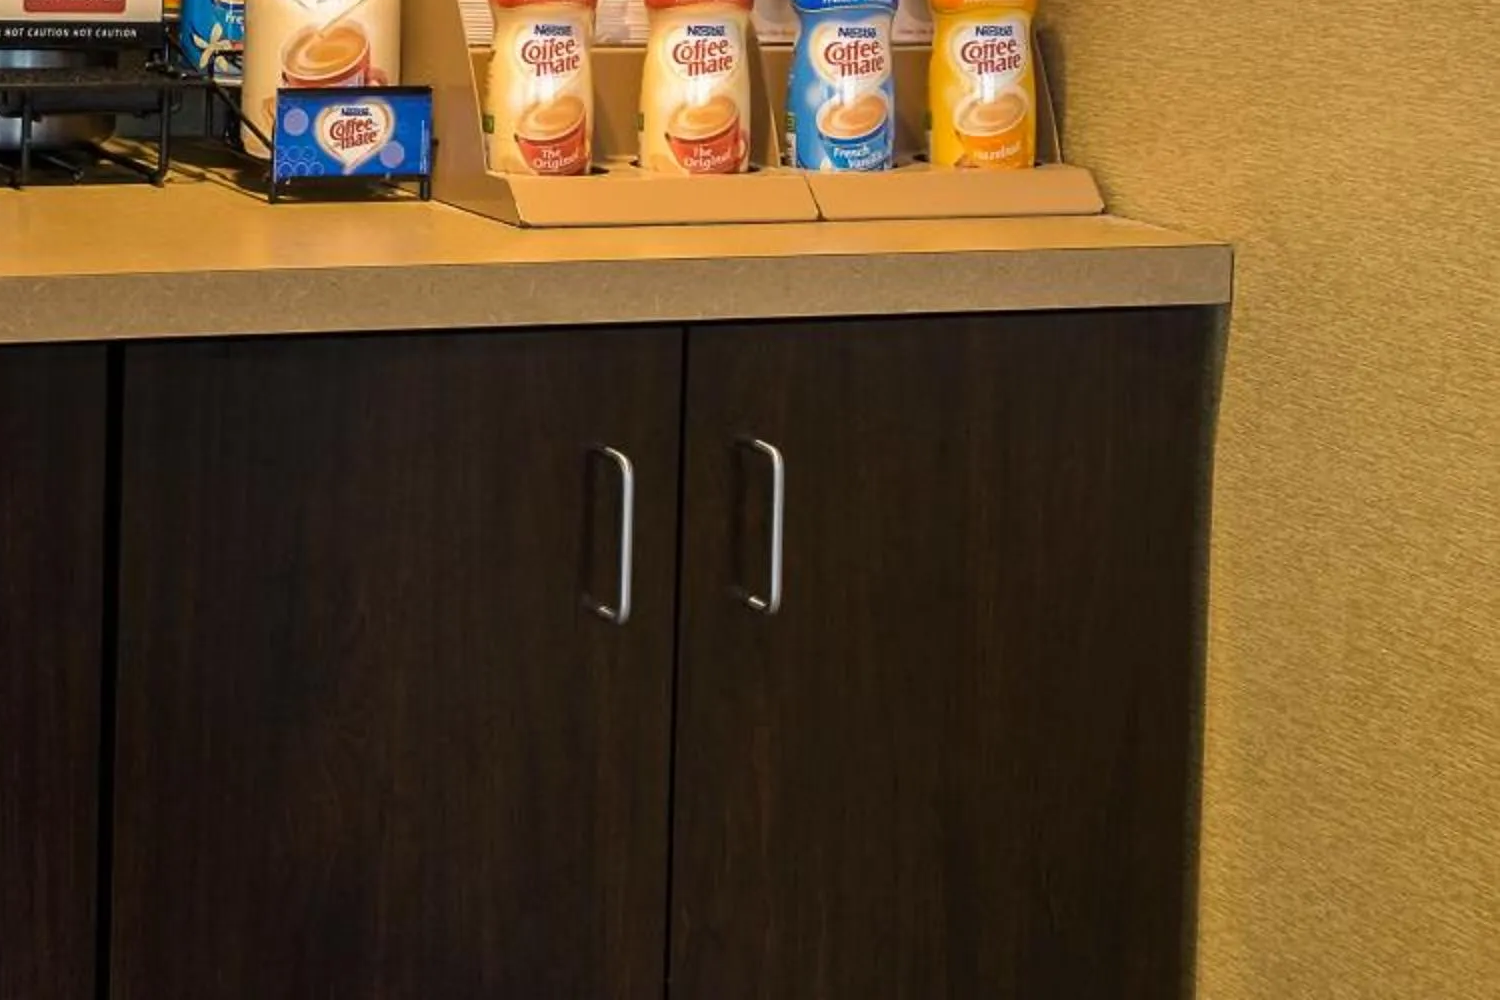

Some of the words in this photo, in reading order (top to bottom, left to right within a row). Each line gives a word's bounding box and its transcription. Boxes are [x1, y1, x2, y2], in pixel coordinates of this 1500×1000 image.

[27, 27, 69, 38] CAUTION
[95, 27, 137, 39] CAUTION
[536, 53, 580, 77] mate
[687, 55, 733, 77] mate
[840, 55, 885, 77] mate
[977, 53, 1021, 75] mate
[341, 129, 378, 150] mate
